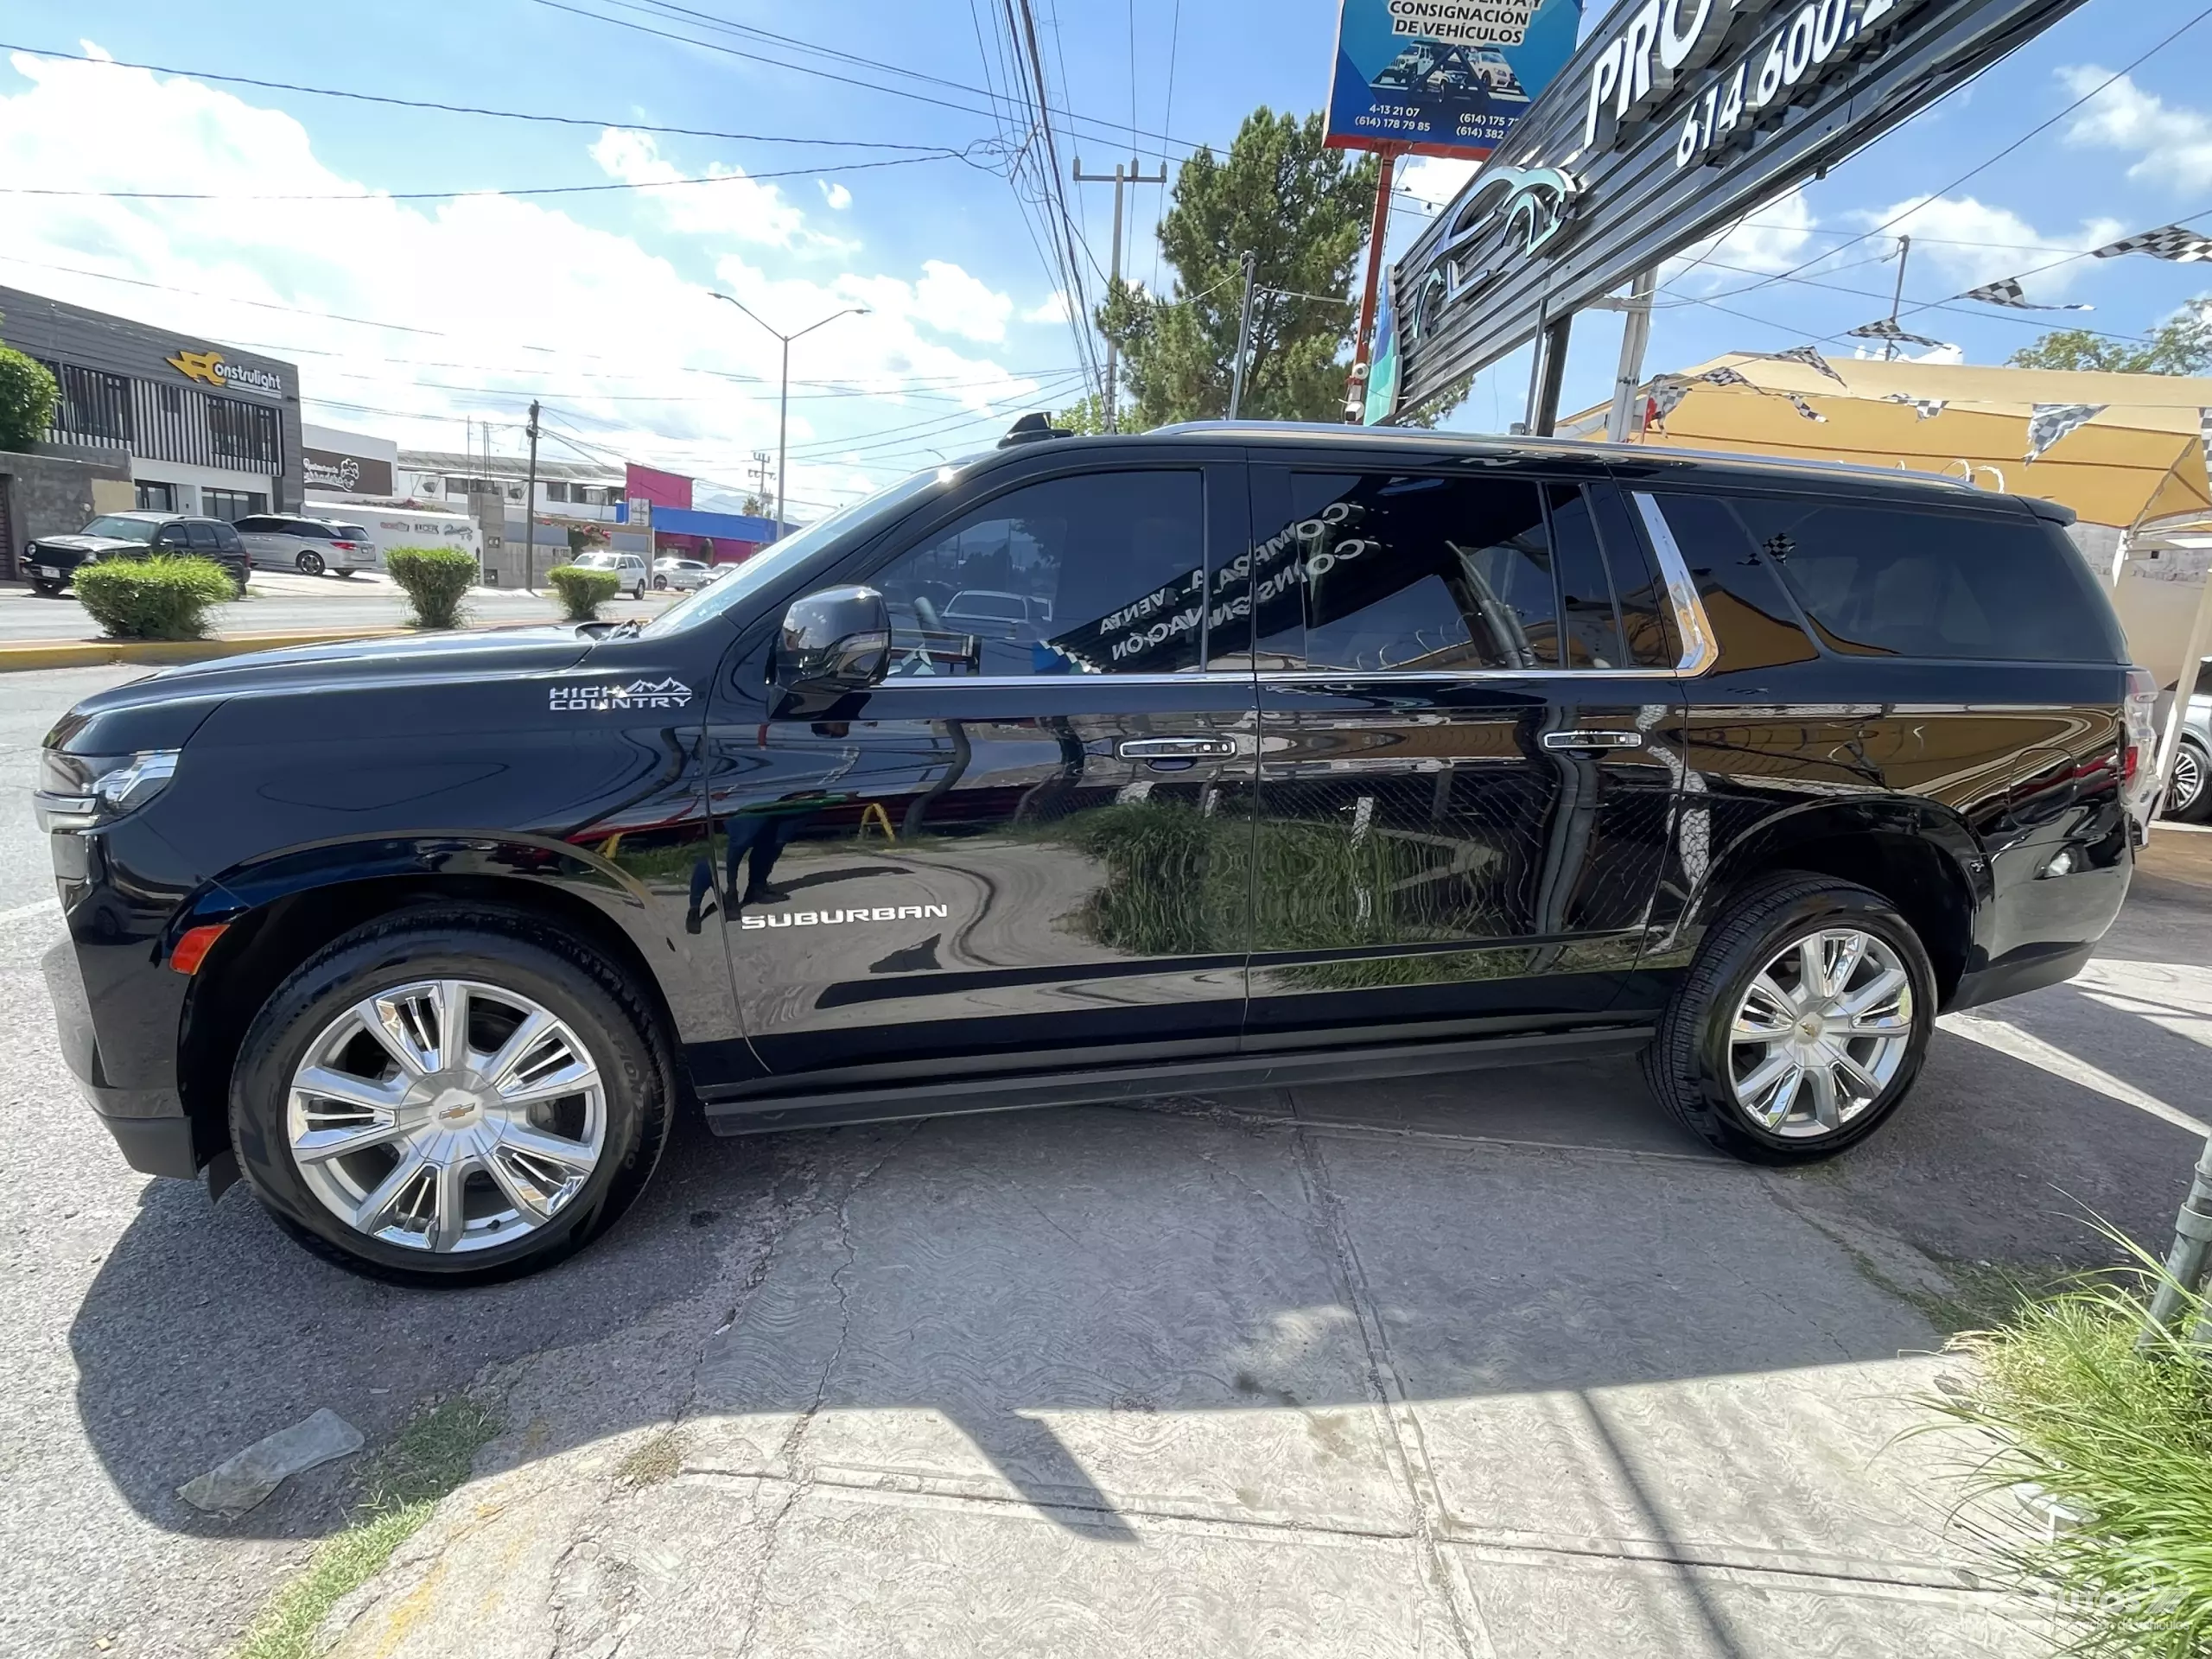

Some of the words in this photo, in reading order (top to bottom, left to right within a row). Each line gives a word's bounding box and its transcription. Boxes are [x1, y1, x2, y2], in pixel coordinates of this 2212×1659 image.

[1389, 1, 1529, 25] CONSIGNACIÓN
[1395, 19, 1419, 34] DE
[1423, 22, 1522, 43] VEHÍCULOS
[1369, 104, 1390, 115] 4-13
[1393, 105, 1403, 117] 21
[1405, 106, 1420, 118] 07
[1676, 60, 1750, 168] 614
[1355, 116, 1381, 128] (614)
[1383, 118, 1400, 129] 178
[1402, 120, 1415, 130] 79
[1417, 121, 1430, 131] 85
[1459, 112, 1486, 125] (614)
[1489, 115, 1505, 126] 175
[1456, 126, 1482, 139] (614)
[1484, 129, 1503, 140] 382
[550, 685, 628, 699] HIGH
[550, 696, 692, 710] COUNTRY
[741, 904, 948, 930] SUBURBAN
